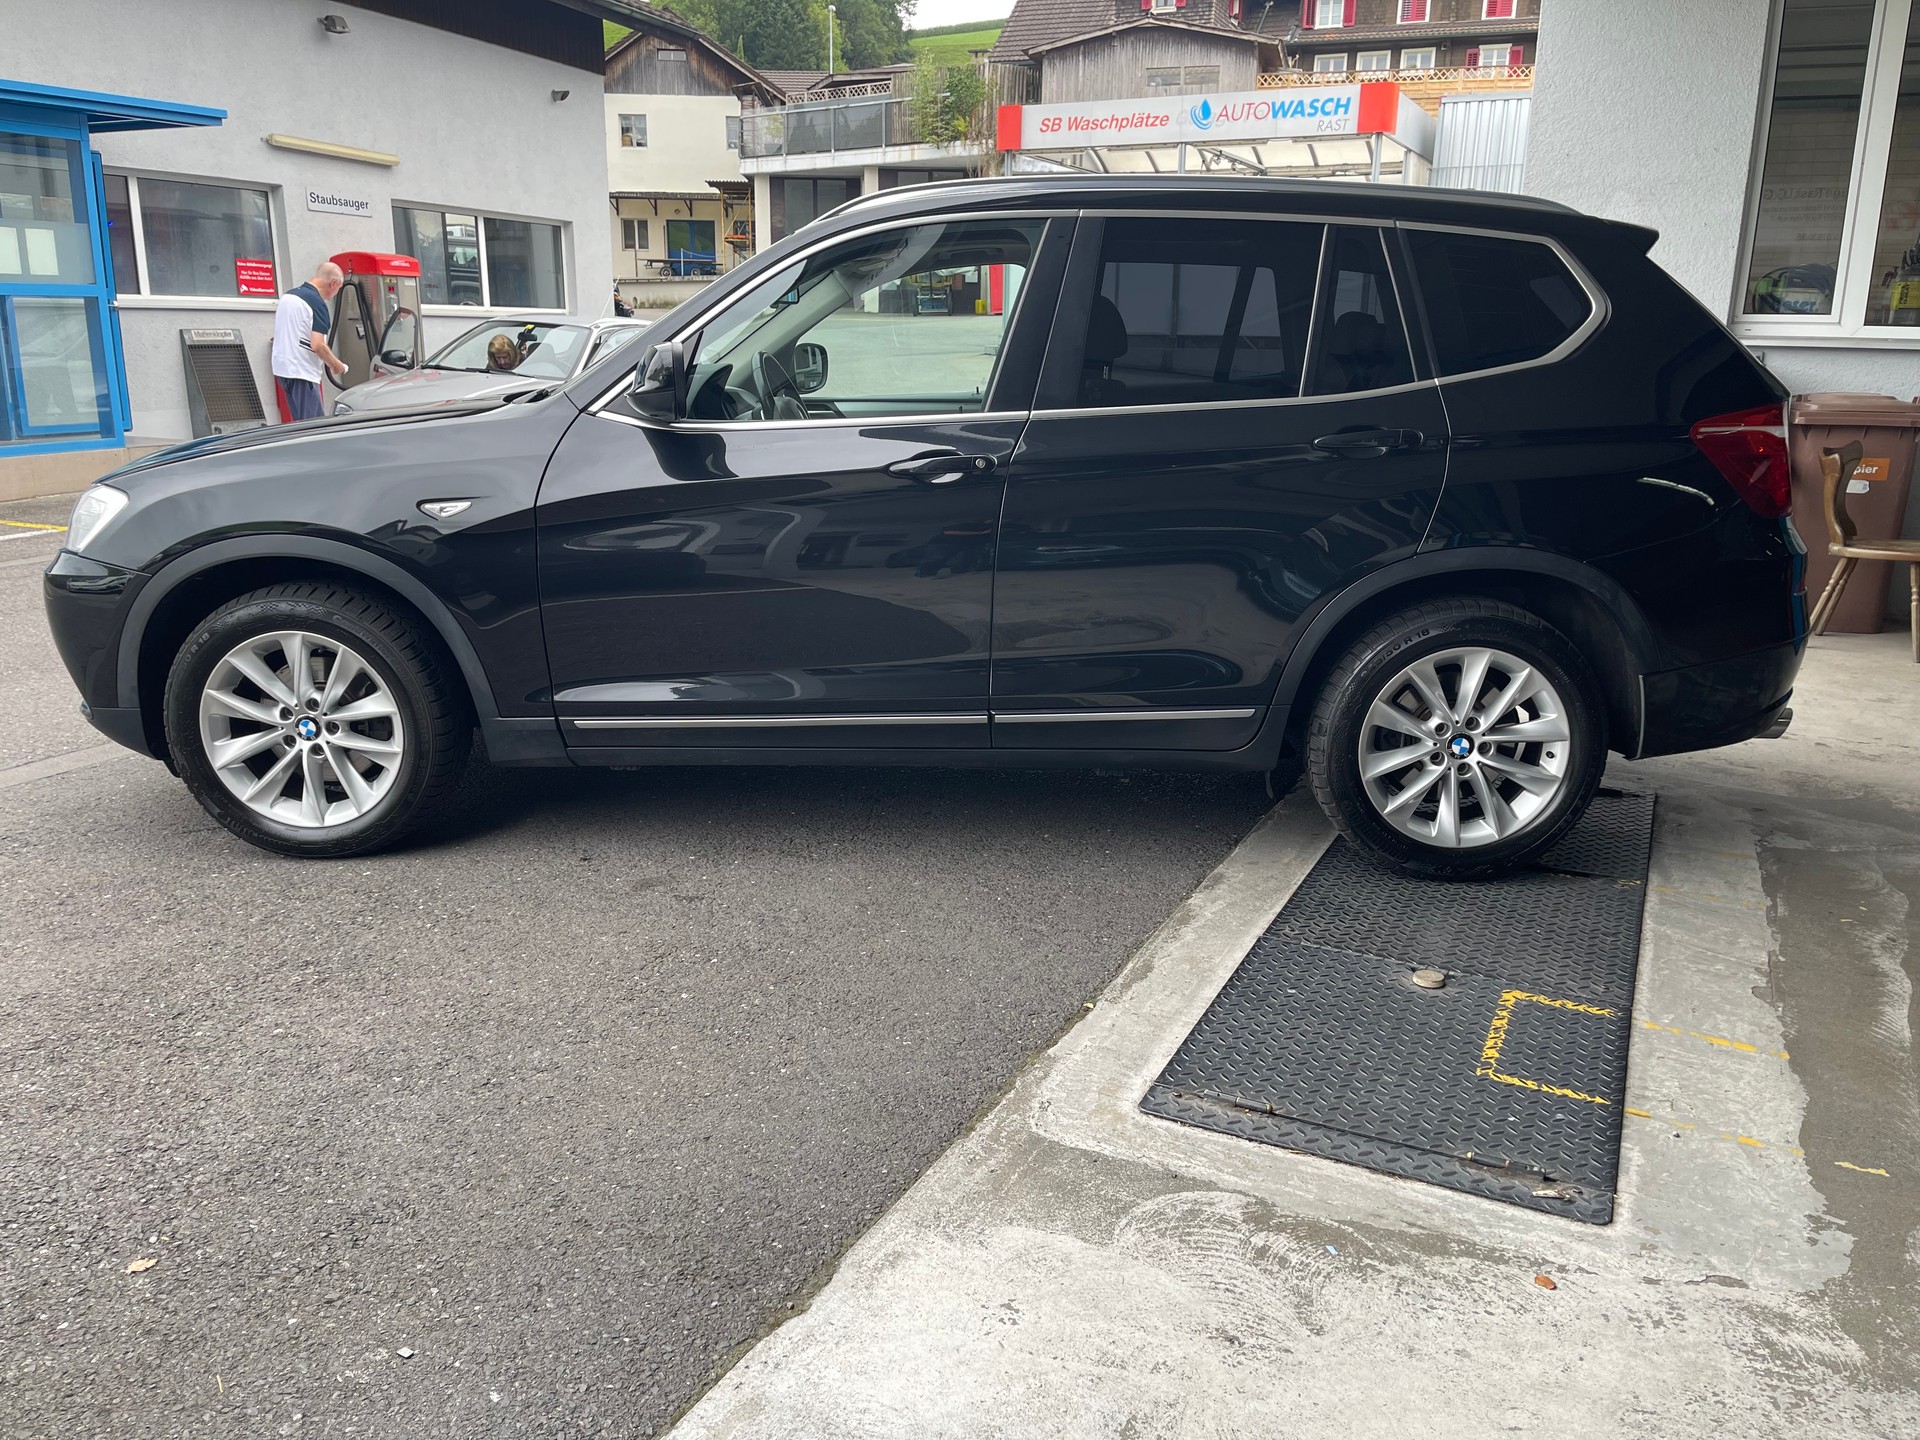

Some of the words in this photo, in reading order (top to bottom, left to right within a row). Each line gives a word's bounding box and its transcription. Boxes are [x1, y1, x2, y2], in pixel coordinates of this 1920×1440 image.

[1216, 96, 1352, 122] AUTOWASCH
[1039, 117, 1063, 133] SB
[1067, 112, 1170, 132] Waschplätze
[1316, 118, 1350, 133] RAST
[309, 191, 369, 211] Staubsauger
[198, 632, 210, 644] 18
[1403, 636, 1413, 645] R
[1415, 628, 1430, 638] 18
